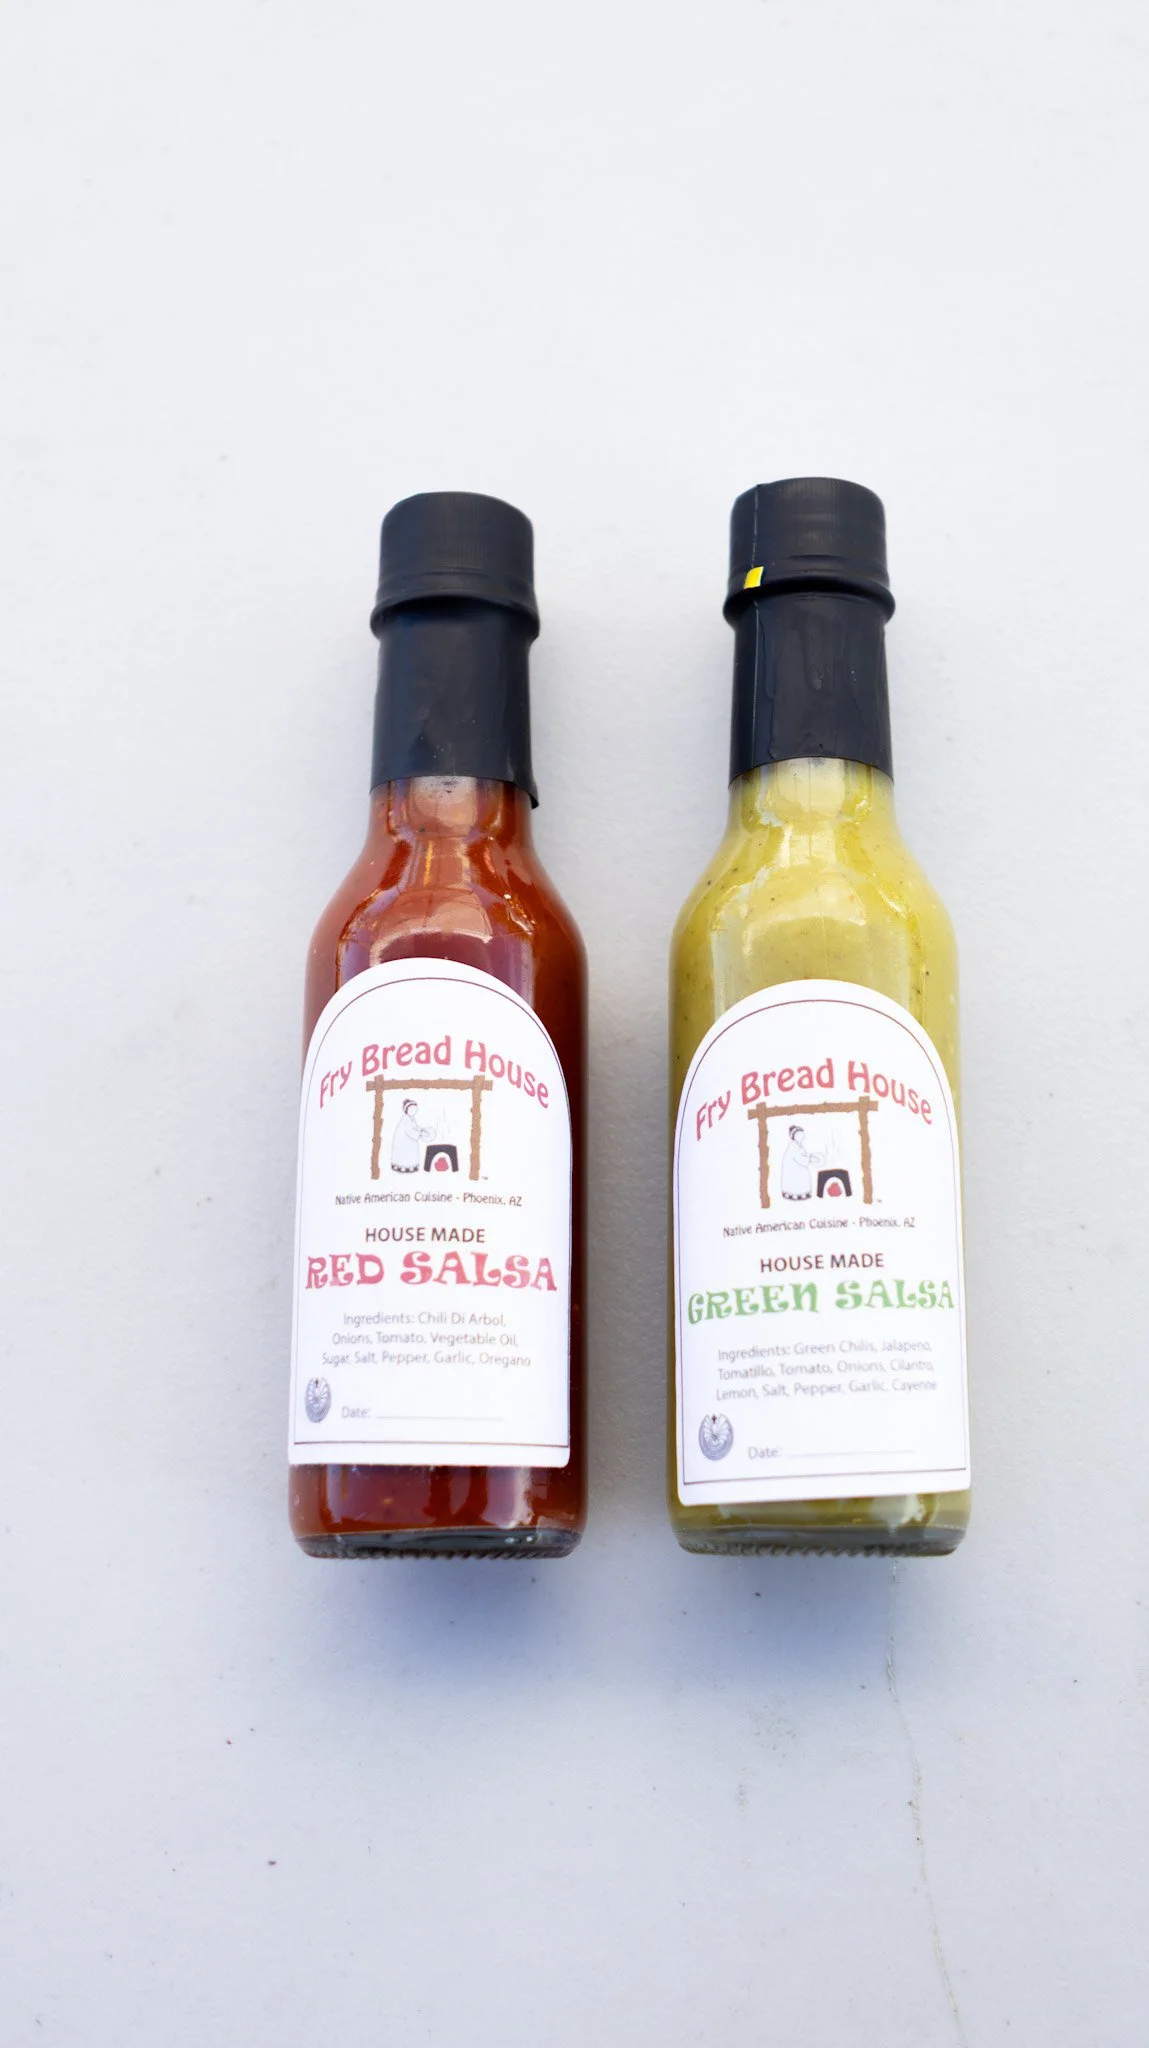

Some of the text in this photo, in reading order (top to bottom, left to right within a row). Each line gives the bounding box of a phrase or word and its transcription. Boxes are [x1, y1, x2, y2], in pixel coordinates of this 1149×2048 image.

[319, 1035, 549, 1109] Fry Bread House
[696, 1057, 932, 1141] Fry Bread House
[335, 1195, 361, 1206] Native
[364, 1192, 410, 1203] American
[414, 1191, 452, 1202] Cuisine
[509, 1196, 522, 1206] AZ
[365, 1227, 485, 1243] HOUSE MADE
[723, 1225, 752, 1238] Native
[755, 1221, 805, 1233] American
[810, 1218, 848, 1229] Cuisine
[904, 1217, 915, 1227] AZ
[305, 1250, 557, 1291] RED SALSA
[760, 1253, 884, 1273] HOUSE MADE
[688, 1279, 955, 1324] GREEN SALSA
[343, 1312, 506, 1328] Ingredients: Chili Di Arbol,
[332, 1331, 519, 1347] Onions, Tomato, Vegetable Oil,
[322, 1350, 531, 1368] Sugar, Salt, Pepper, Garlic, Oregano
[718, 1345, 790, 1362] Ingredients:
[794, 1342, 835, 1355] Green
[718, 1365, 775, 1380] Tomatillo,
[779, 1363, 833, 1375] Tomato,
[838, 1360, 887, 1372] Onions,
[716, 1388, 759, 1401] Lemon,
[762, 1383, 789, 1396] Salt,
[794, 1381, 845, 1397] Pepper,
[892, 1379, 937, 1393] Cayenne
[342, 1406, 371, 1418] Date:
[748, 1446, 782, 1459] Date:
